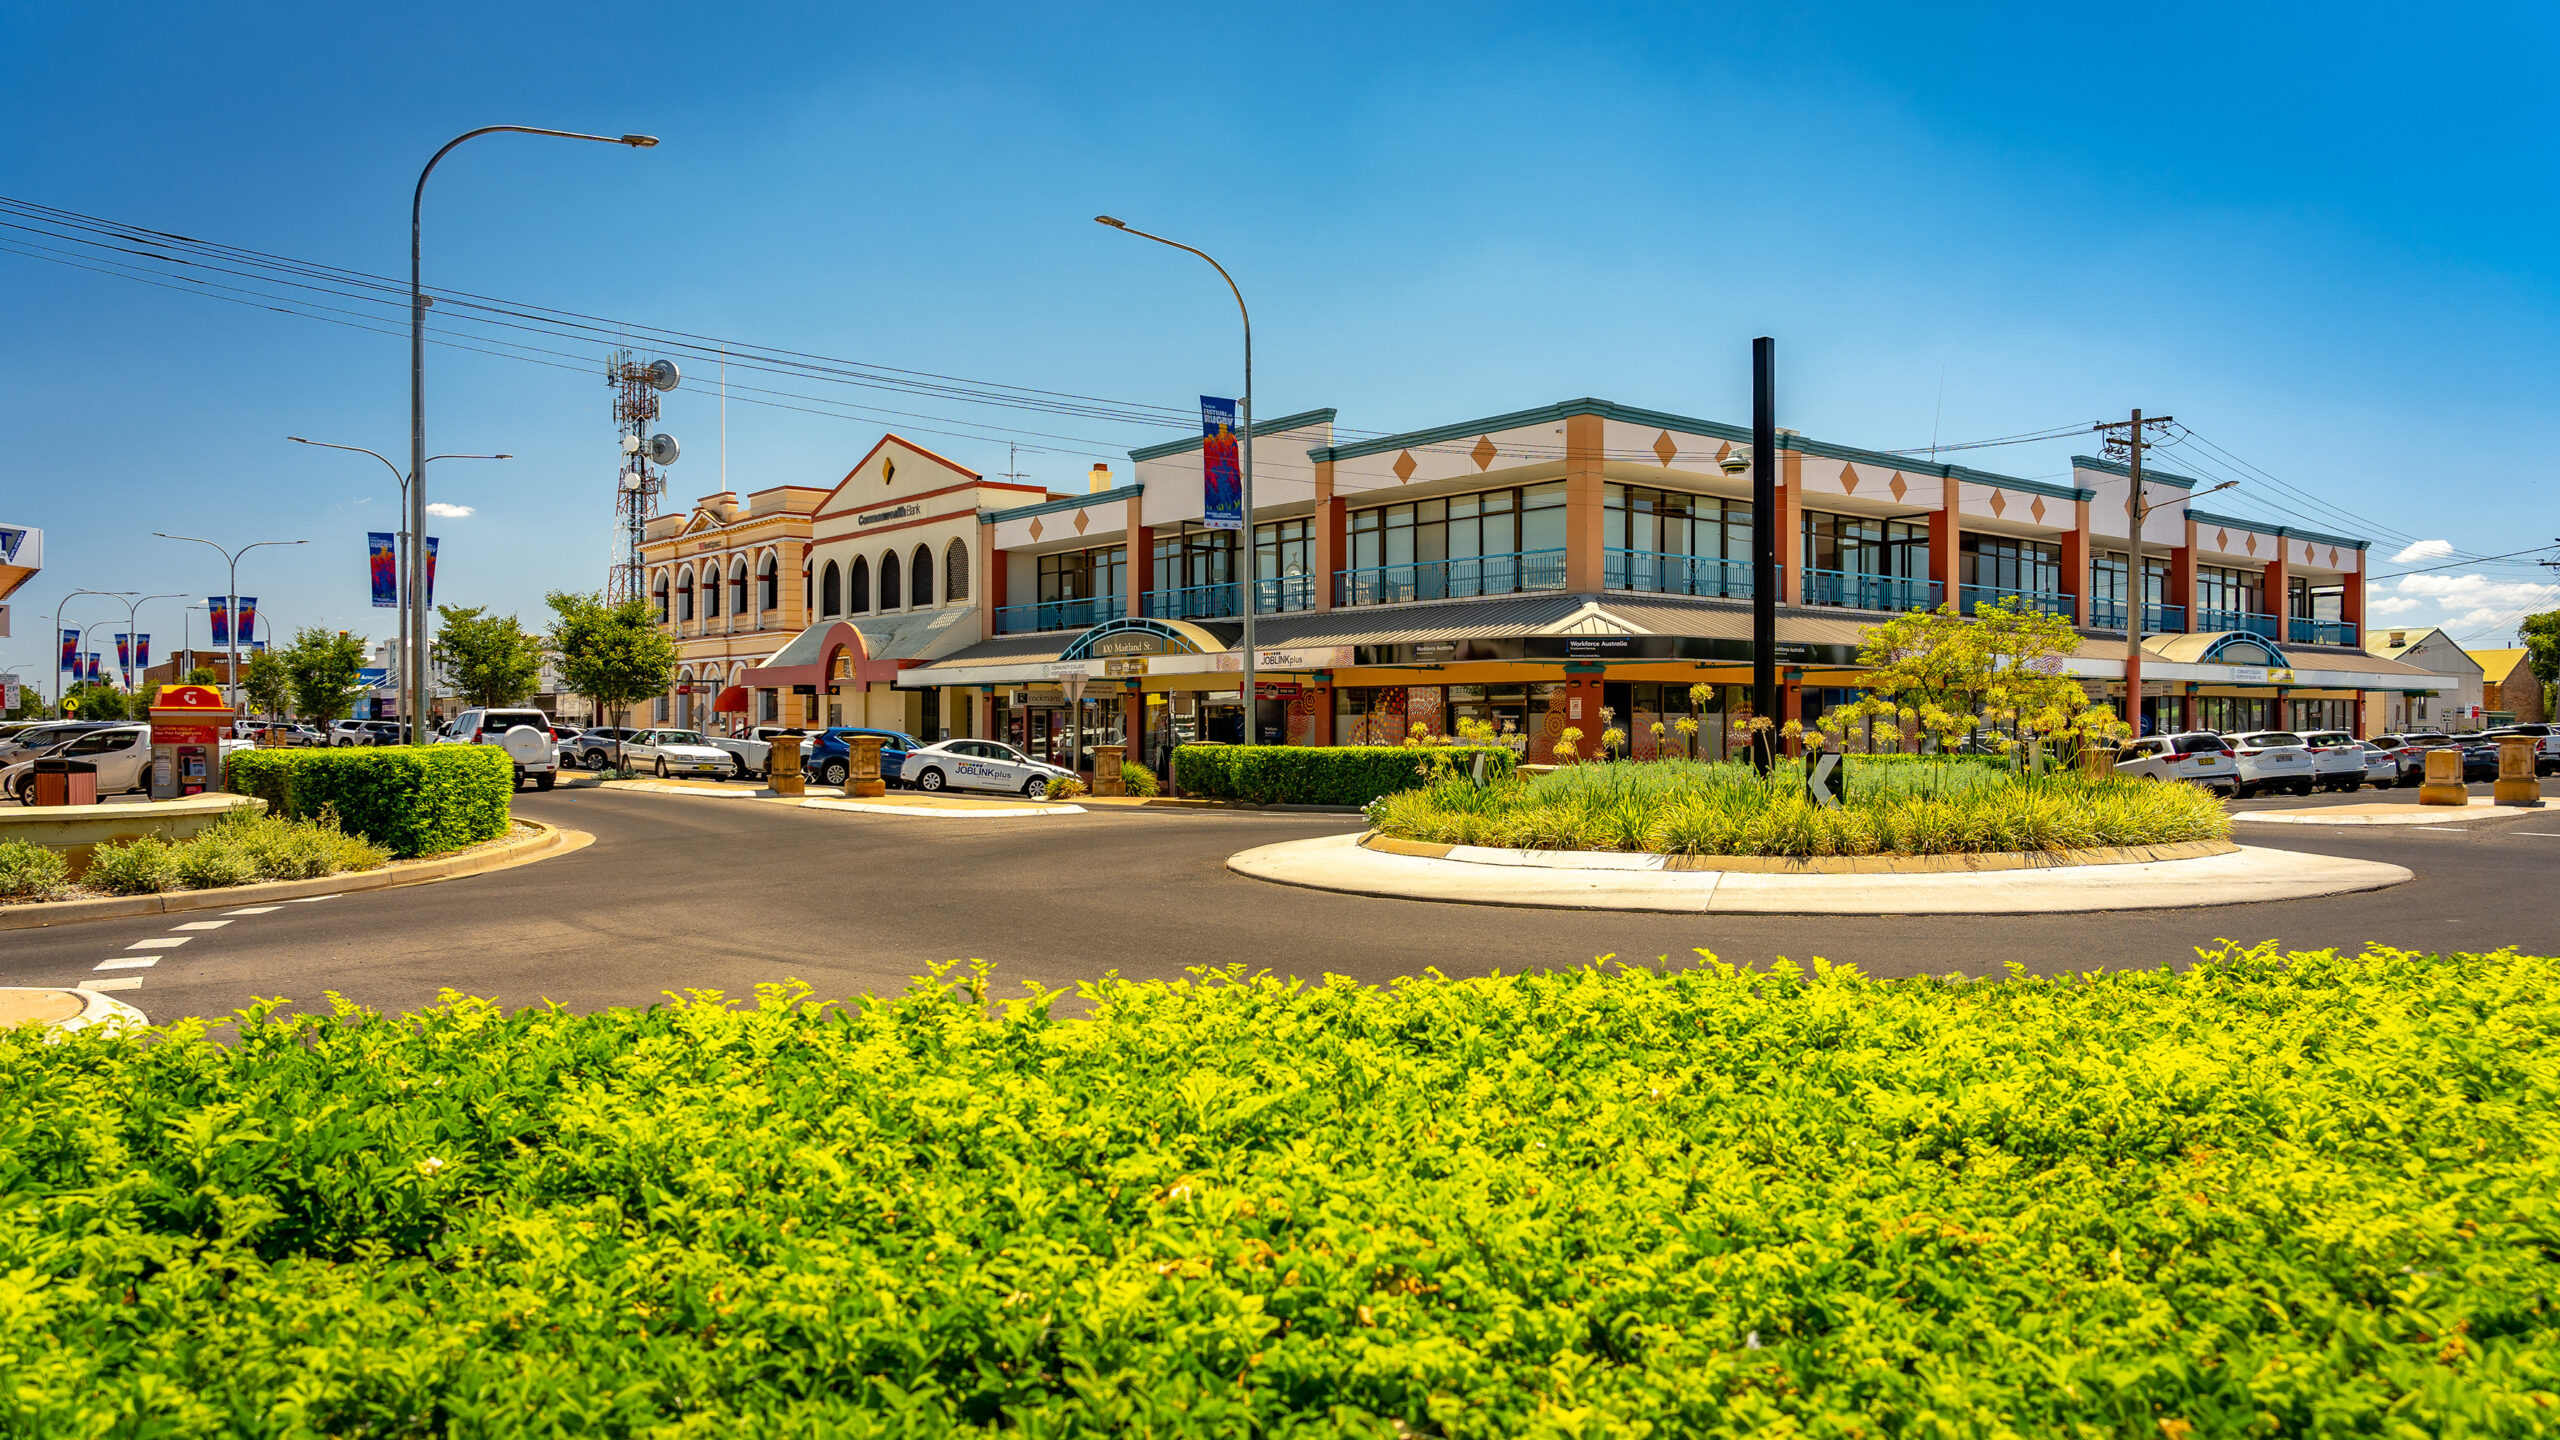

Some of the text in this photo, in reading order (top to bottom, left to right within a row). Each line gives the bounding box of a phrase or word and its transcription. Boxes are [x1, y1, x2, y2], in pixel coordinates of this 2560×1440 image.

[1204, 414, 1233, 426] RUGBY
[1103, 644, 1112, 653] 100
[1114, 642, 1142, 652] Maitland
[1029, 693, 1061, 701] rockmans
